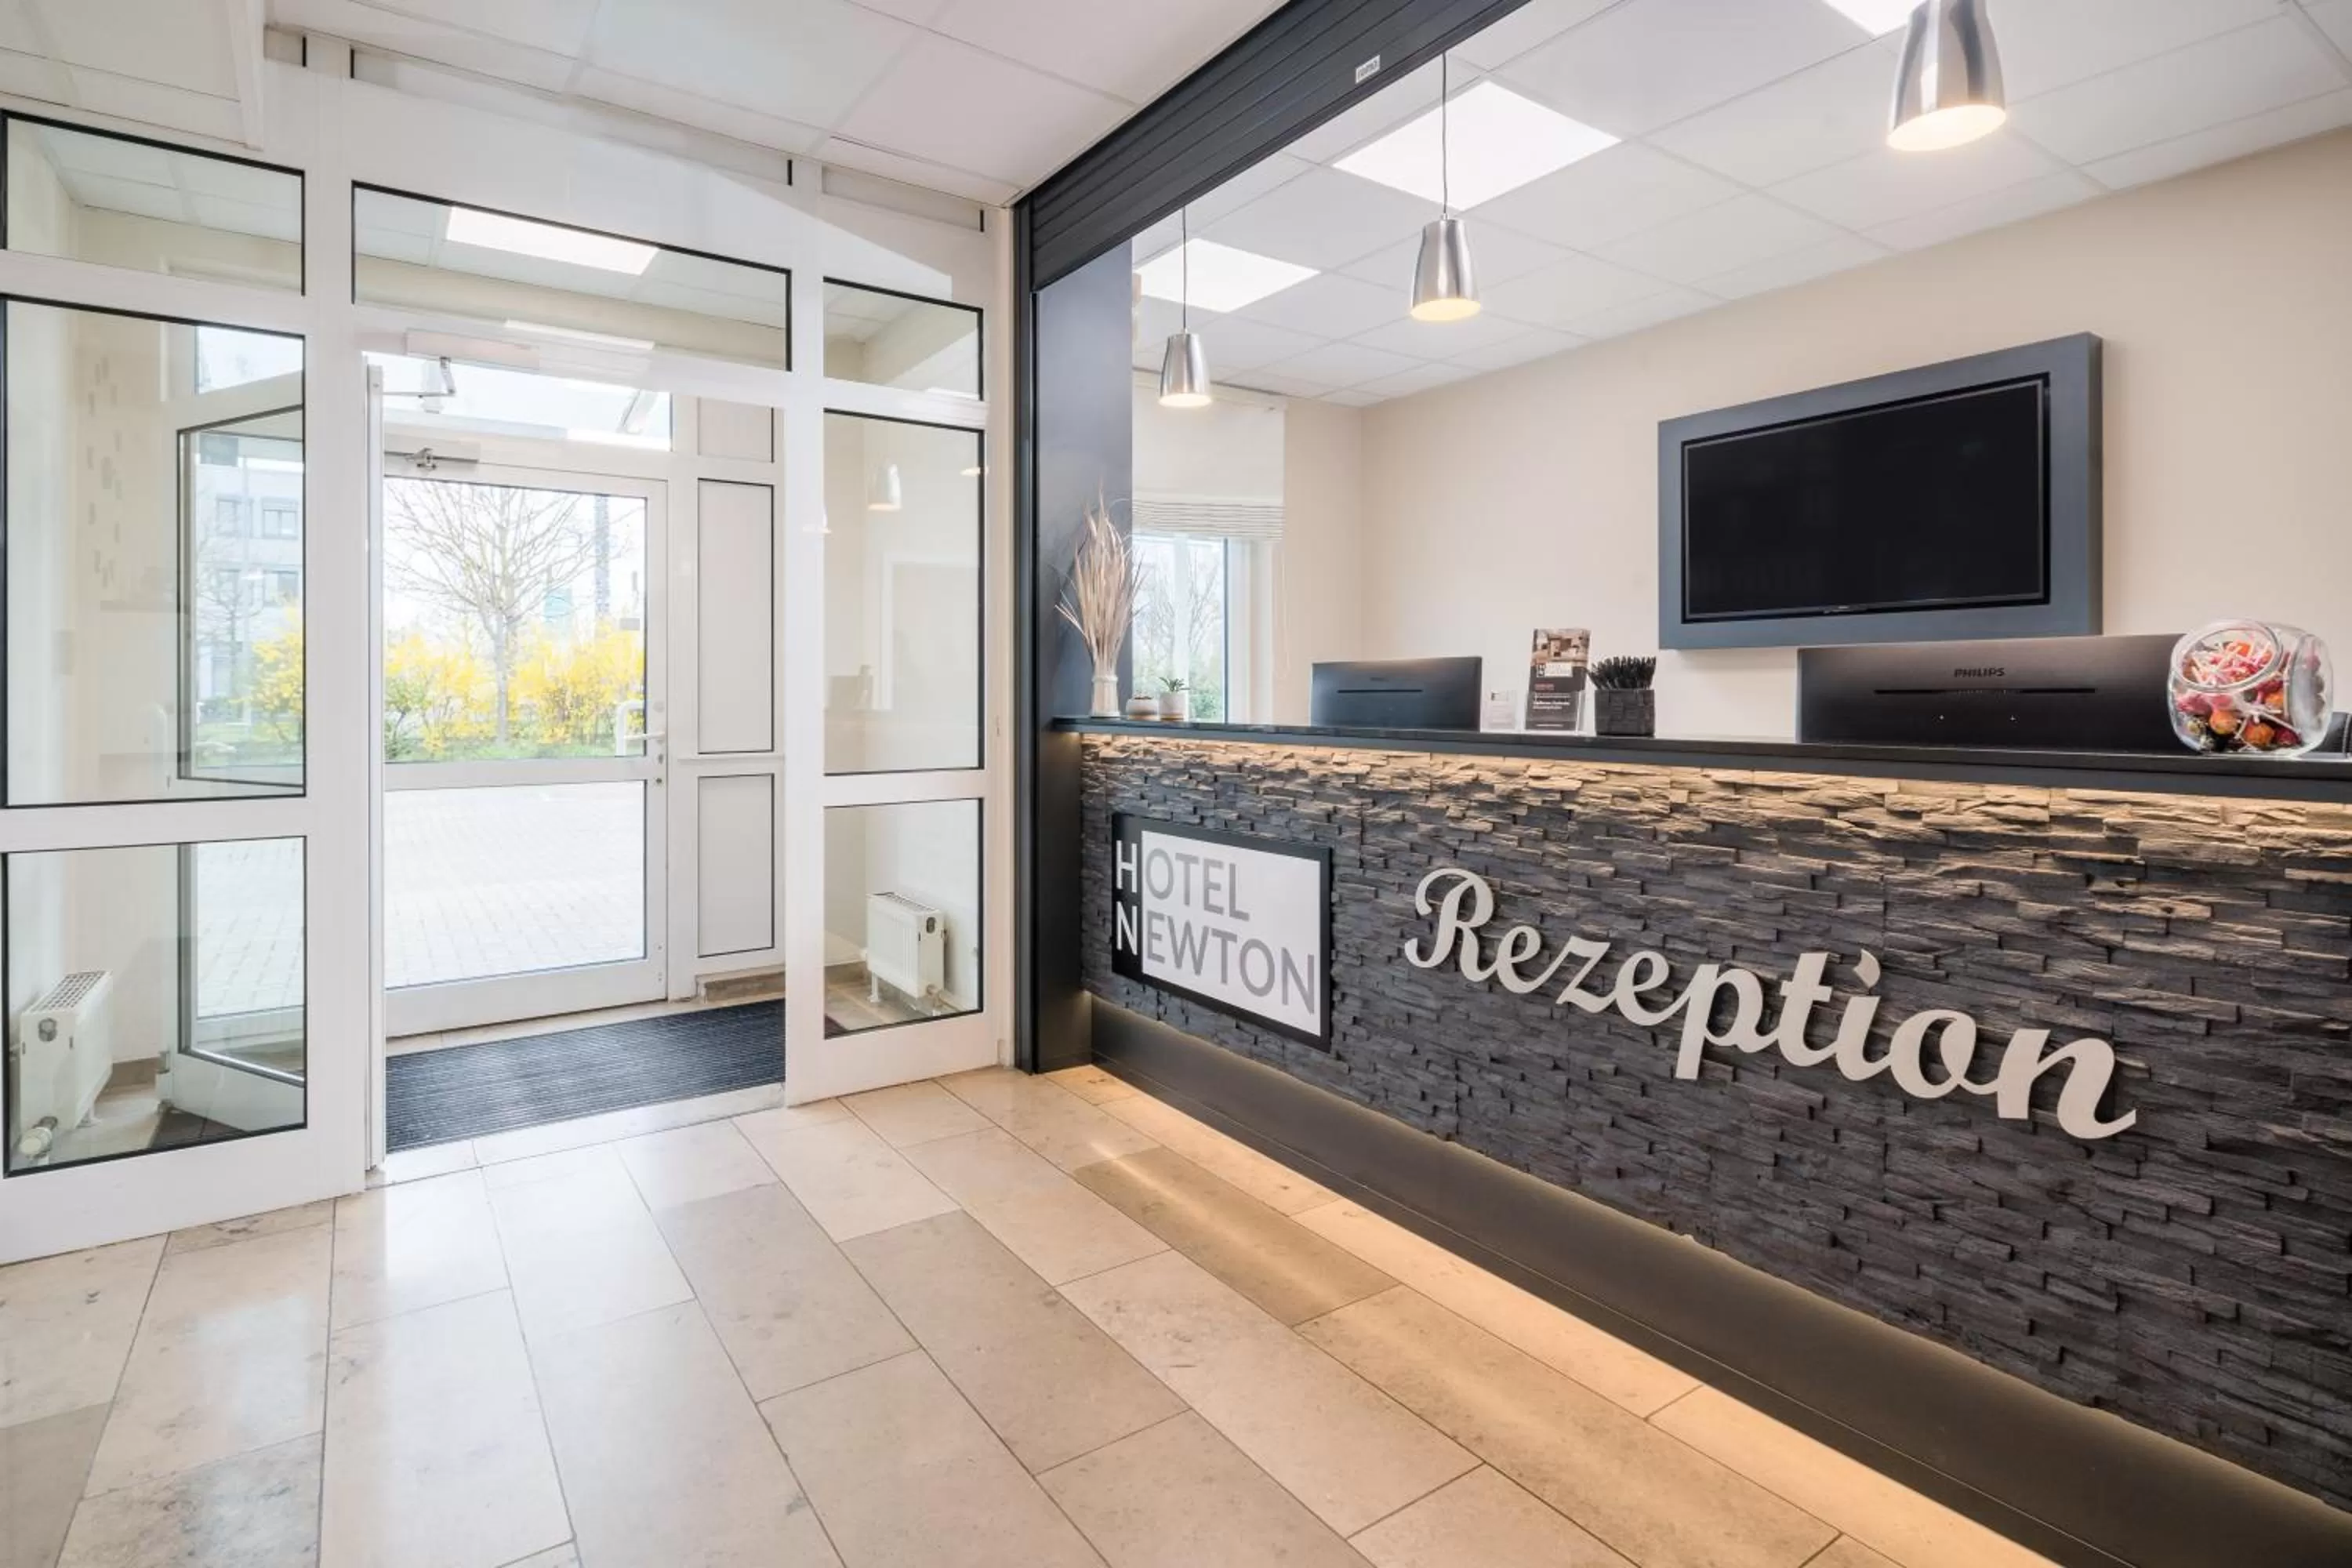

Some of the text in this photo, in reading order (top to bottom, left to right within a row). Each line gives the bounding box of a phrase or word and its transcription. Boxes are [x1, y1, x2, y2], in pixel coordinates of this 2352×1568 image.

[1954, 667, 2005, 677] PHILIPS
[1116, 840, 1250, 921] HOTEL
[1116, 901, 1315, 1014] NEWTON
[1403, 868, 2136, 1140] Rezeption
